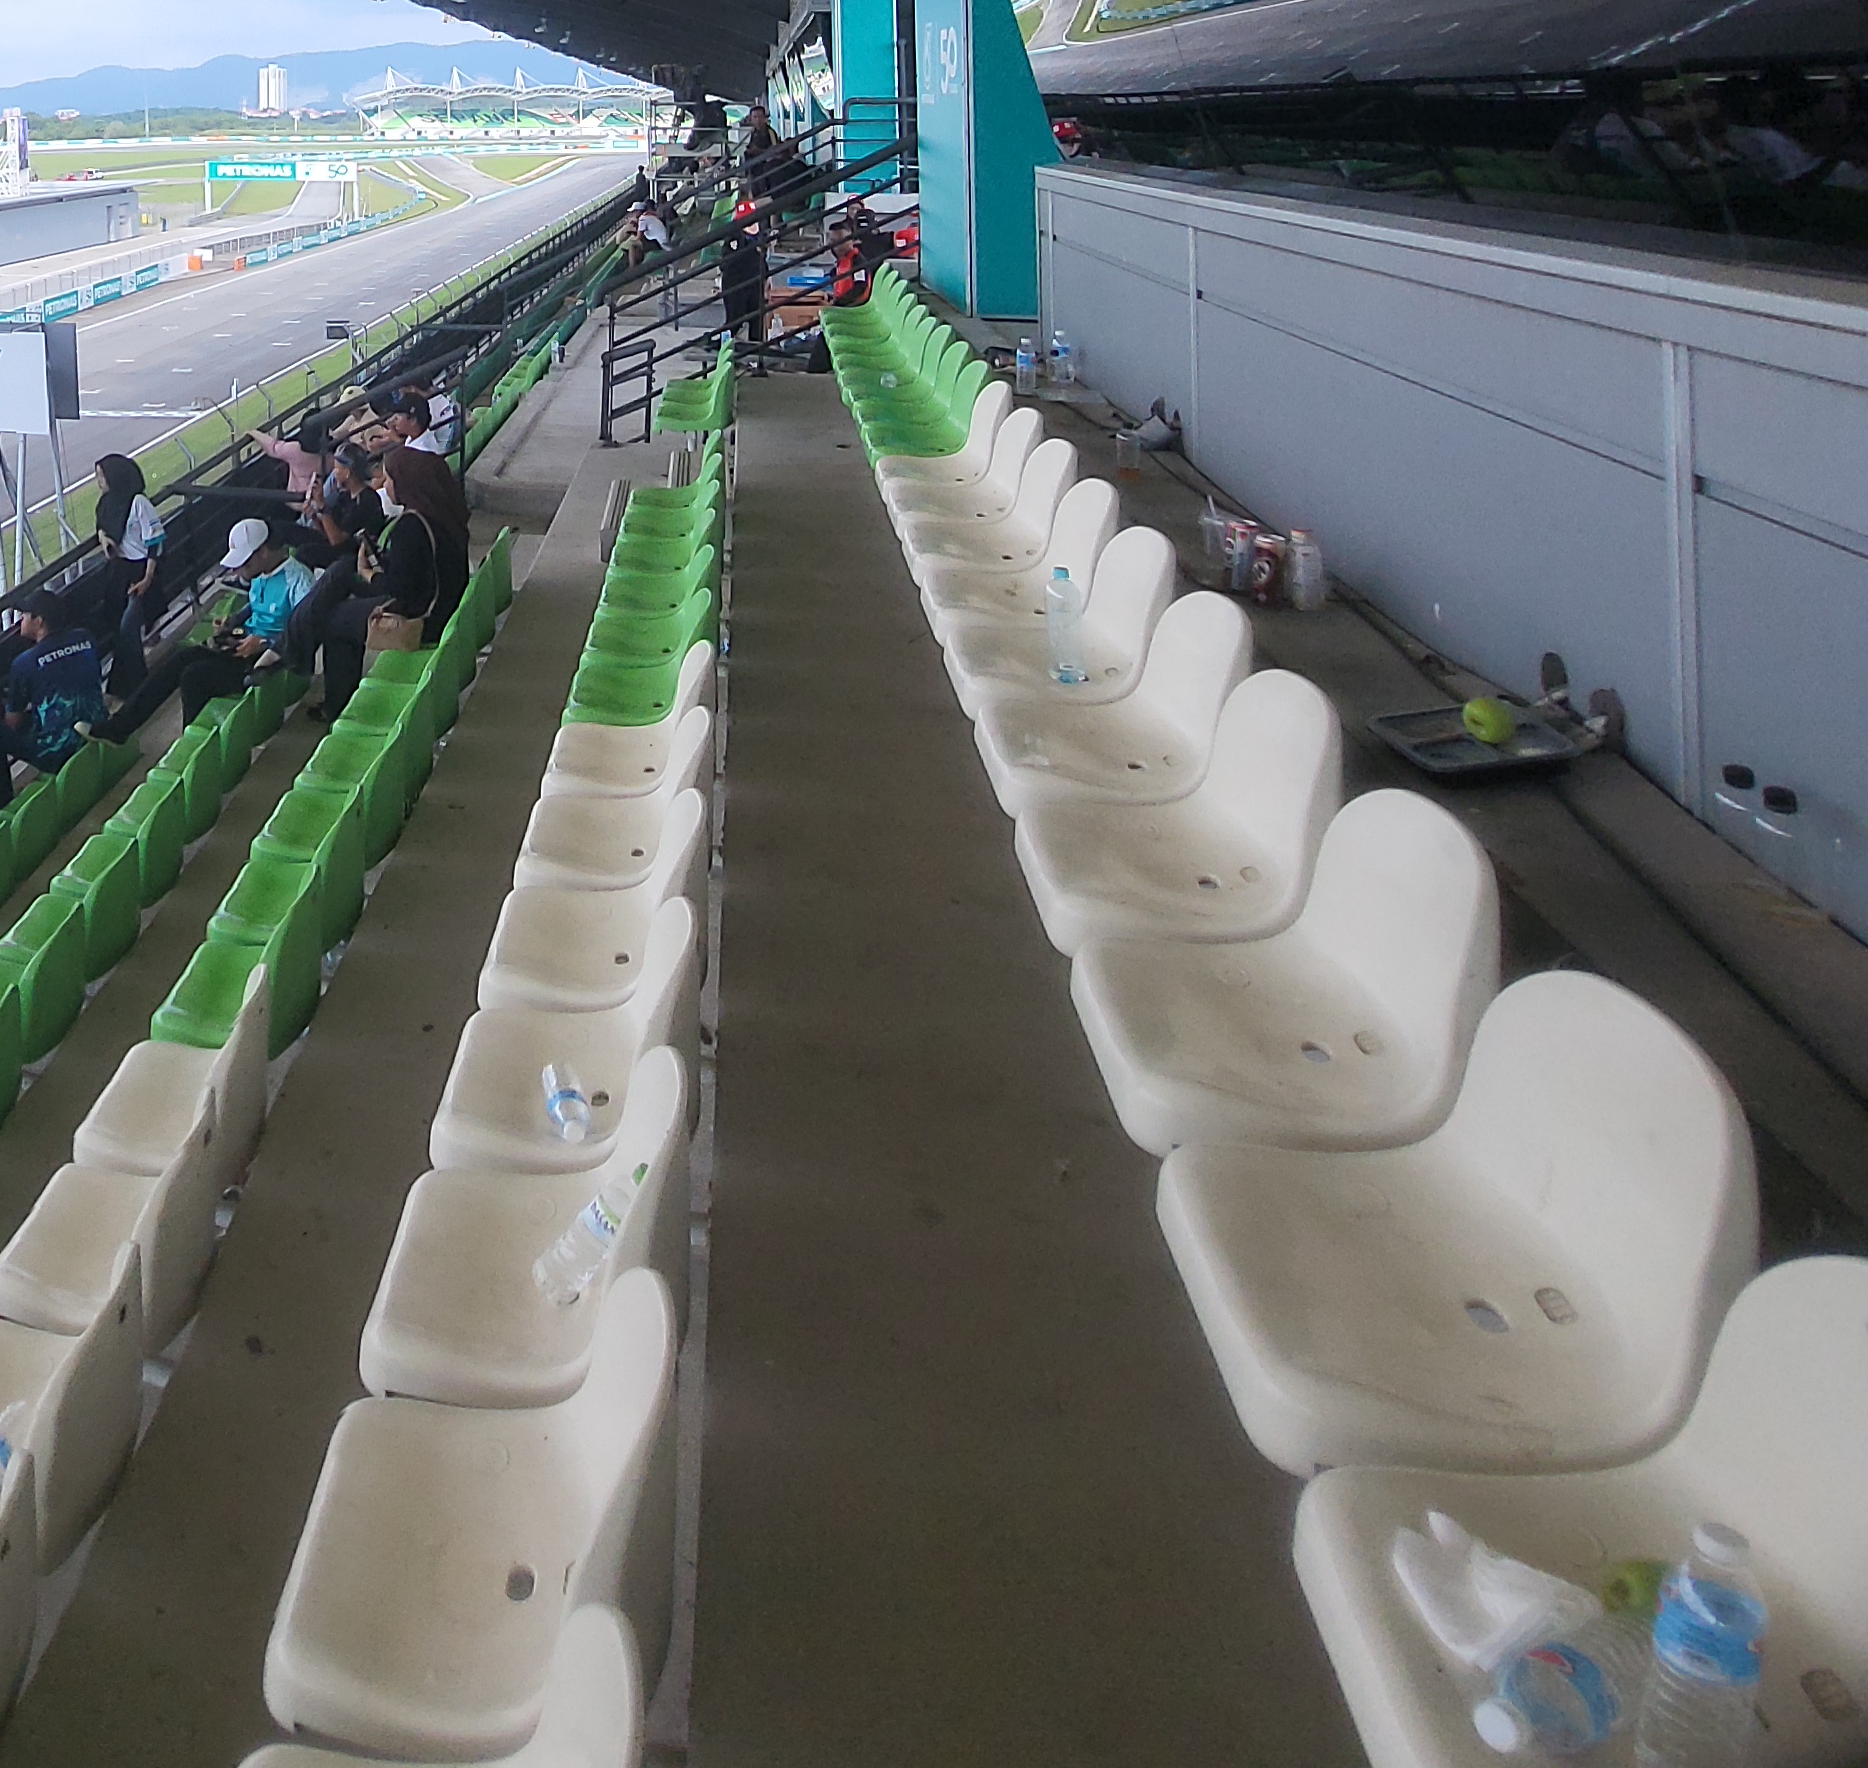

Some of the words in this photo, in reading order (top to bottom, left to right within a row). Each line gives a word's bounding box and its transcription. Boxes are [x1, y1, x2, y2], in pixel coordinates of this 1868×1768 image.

[940, 26, 958, 94] 50
[217, 164, 292, 177] PETRONAS
[328, 164, 348, 179] 50
[45, 293, 78, 317] PETRONAS
[37, 640, 93, 667] PETRONAS
